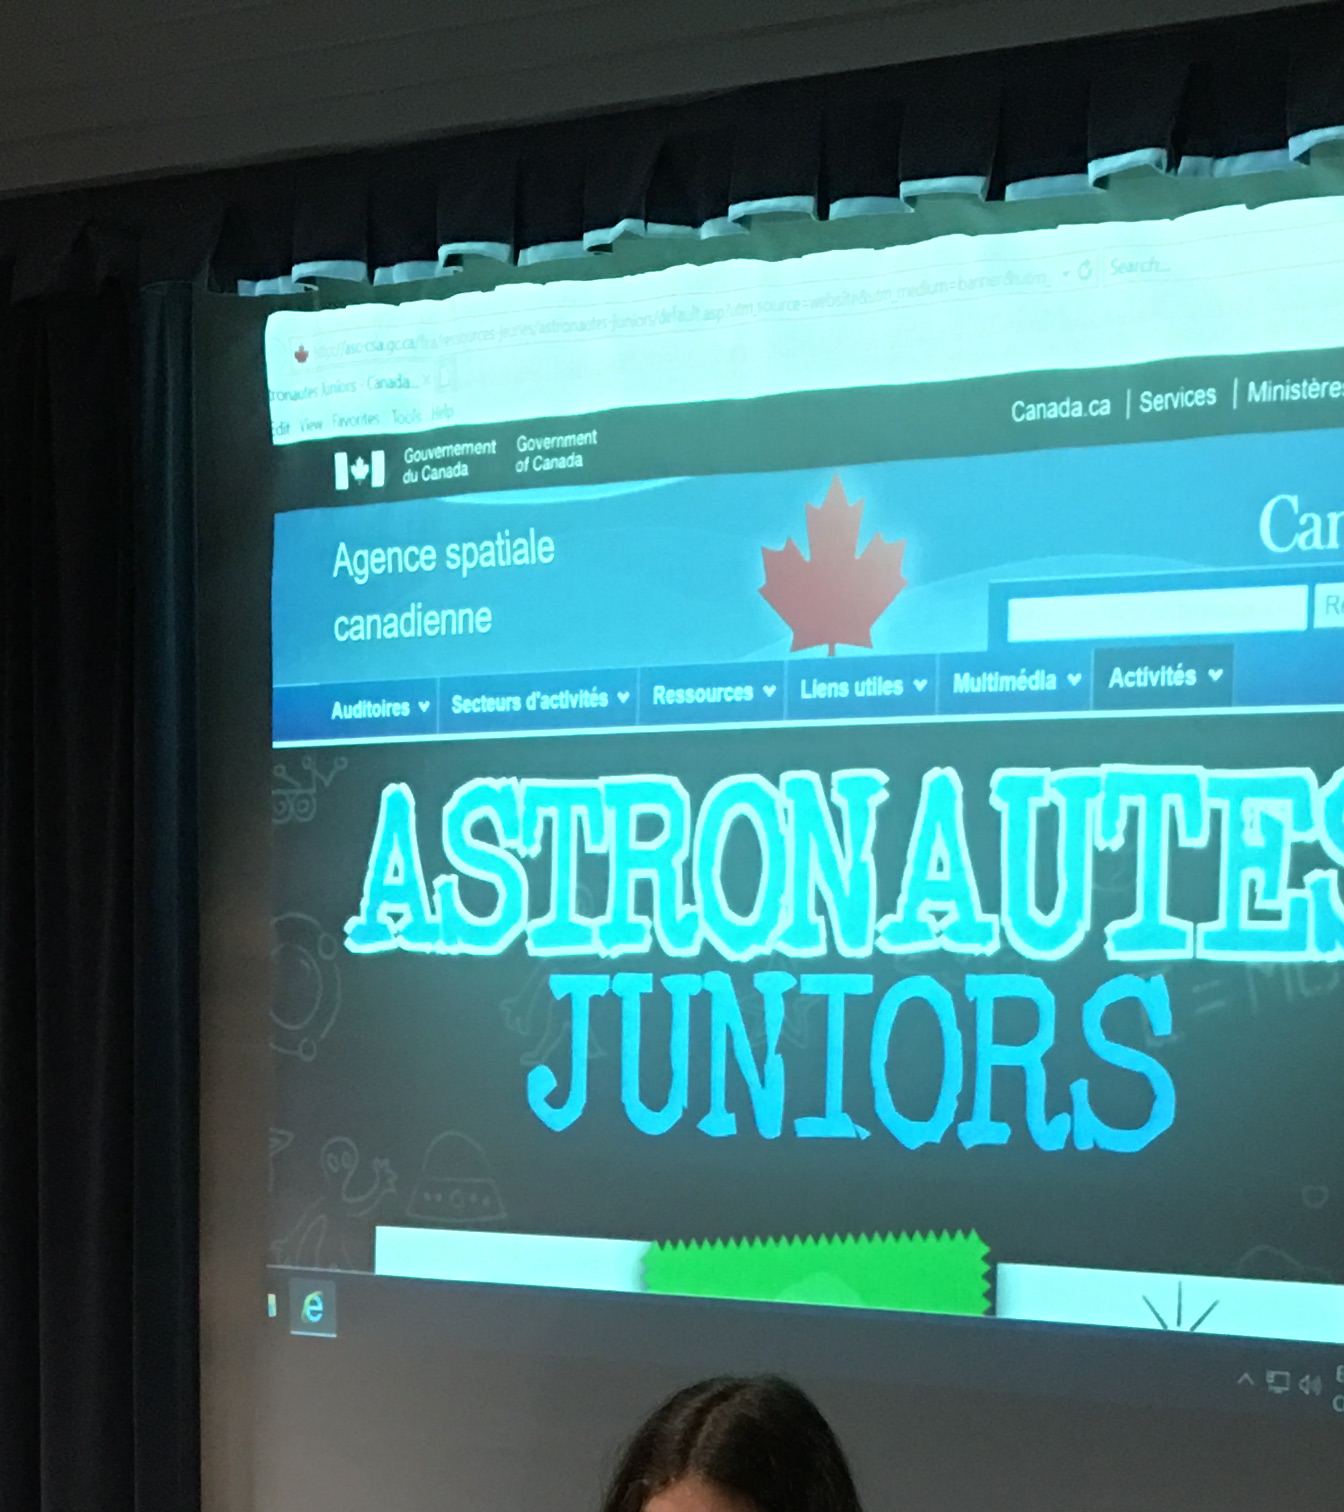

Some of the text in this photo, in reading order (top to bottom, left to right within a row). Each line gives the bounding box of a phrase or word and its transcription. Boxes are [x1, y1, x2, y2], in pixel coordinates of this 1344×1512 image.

[1011, 395, 1111, 423] Canada.ca
[1139, 384, 1218, 413] Services
[403, 438, 497, 464] Gouvernement
[516, 429, 598, 454] Government
[403, 458, 470, 484] du Canada
[515, 450, 584, 473] of Canada
[333, 527, 556, 586] Agence spatiale
[333, 602, 493, 643] canadienne
[800, 675, 904, 700] Liens utiles
[953, 667, 1057, 694] Multimédia
[1108, 663, 1197, 690] Activités
[451, 685, 609, 715] Secteurs d'activités
[652, 682, 754, 706] Ressources
[331, 697, 411, 722] Auditoires
[527, 970, 1177, 1153] JUNIORS
